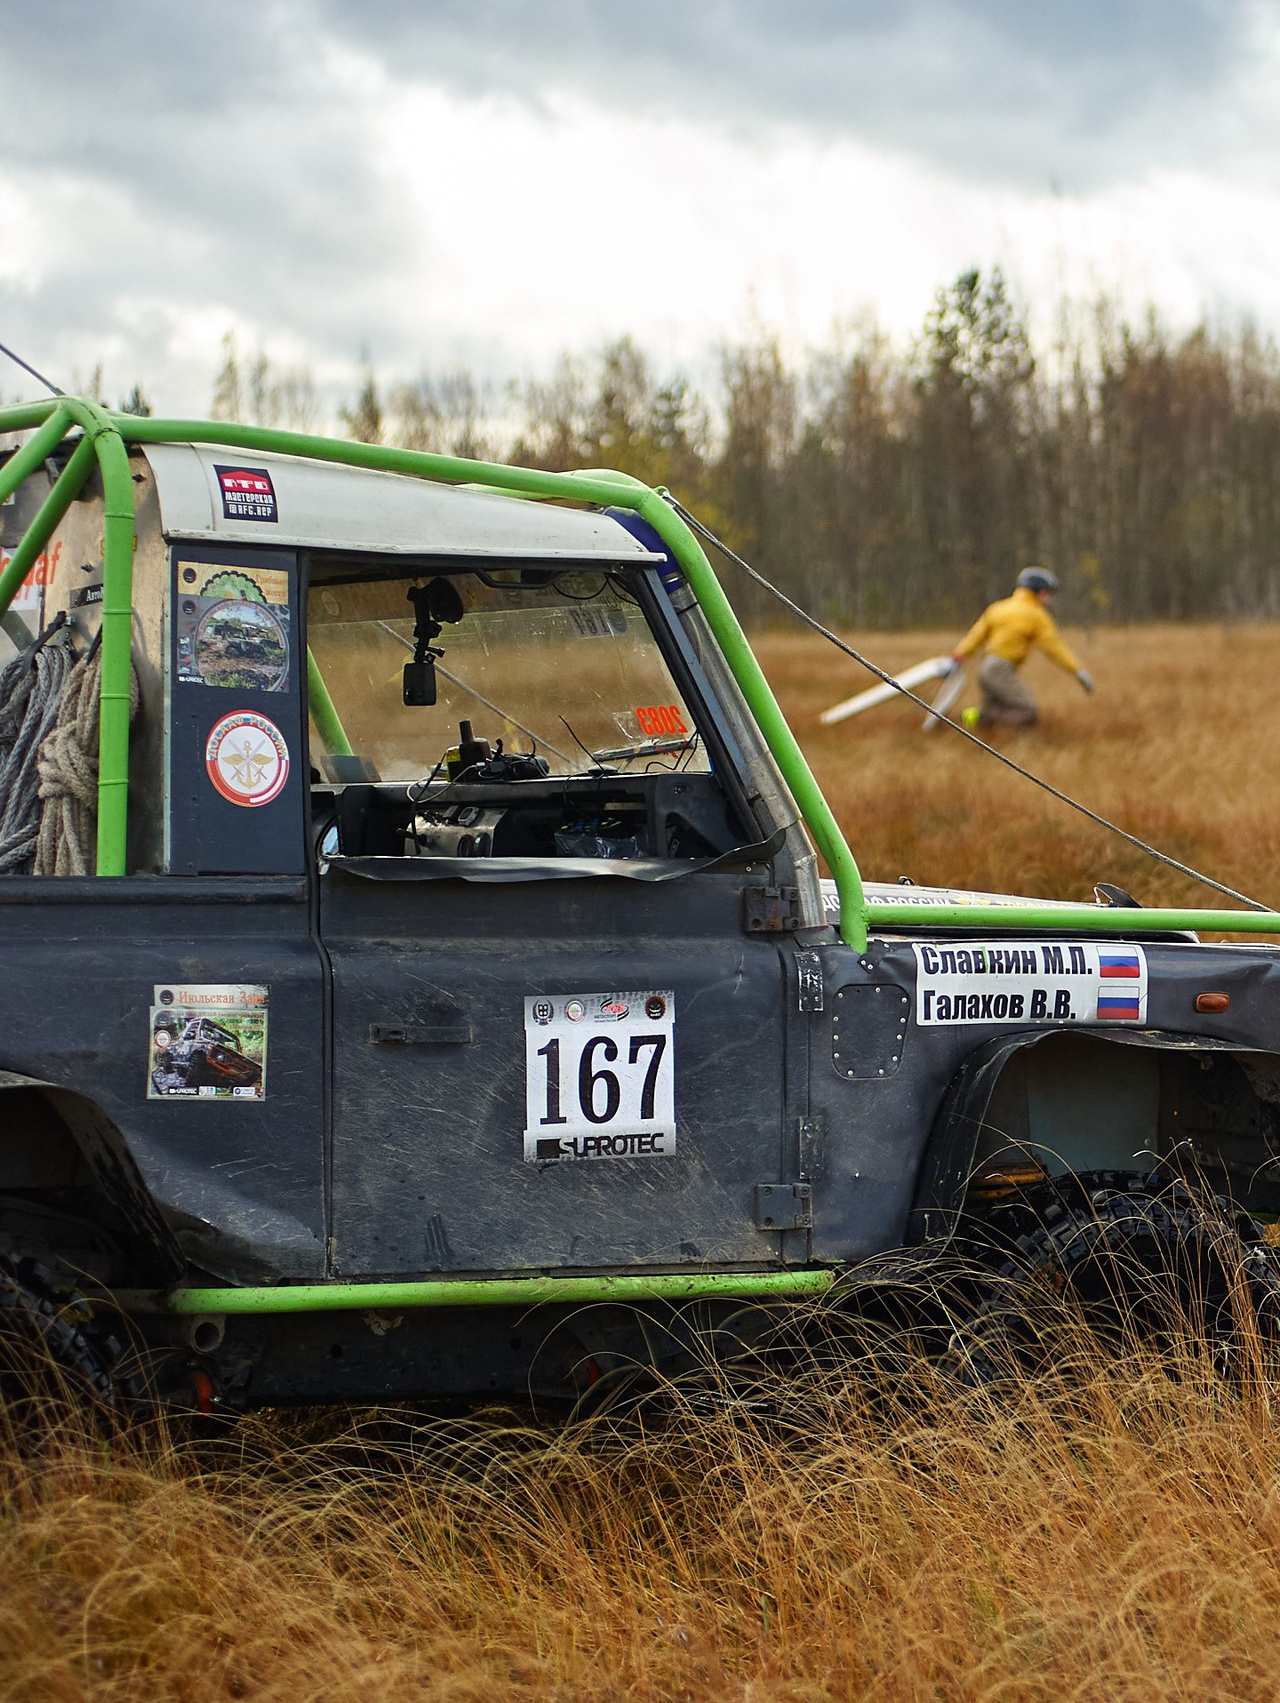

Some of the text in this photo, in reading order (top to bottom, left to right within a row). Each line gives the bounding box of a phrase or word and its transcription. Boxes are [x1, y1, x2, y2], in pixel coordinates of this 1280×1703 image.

[921, 945, 1093, 976] Славкин М.П.
[179, 991, 235, 1004] Июльская
[923, 988, 1076, 1021] Галахов В.В.
[537, 1033, 667, 1126] 167
